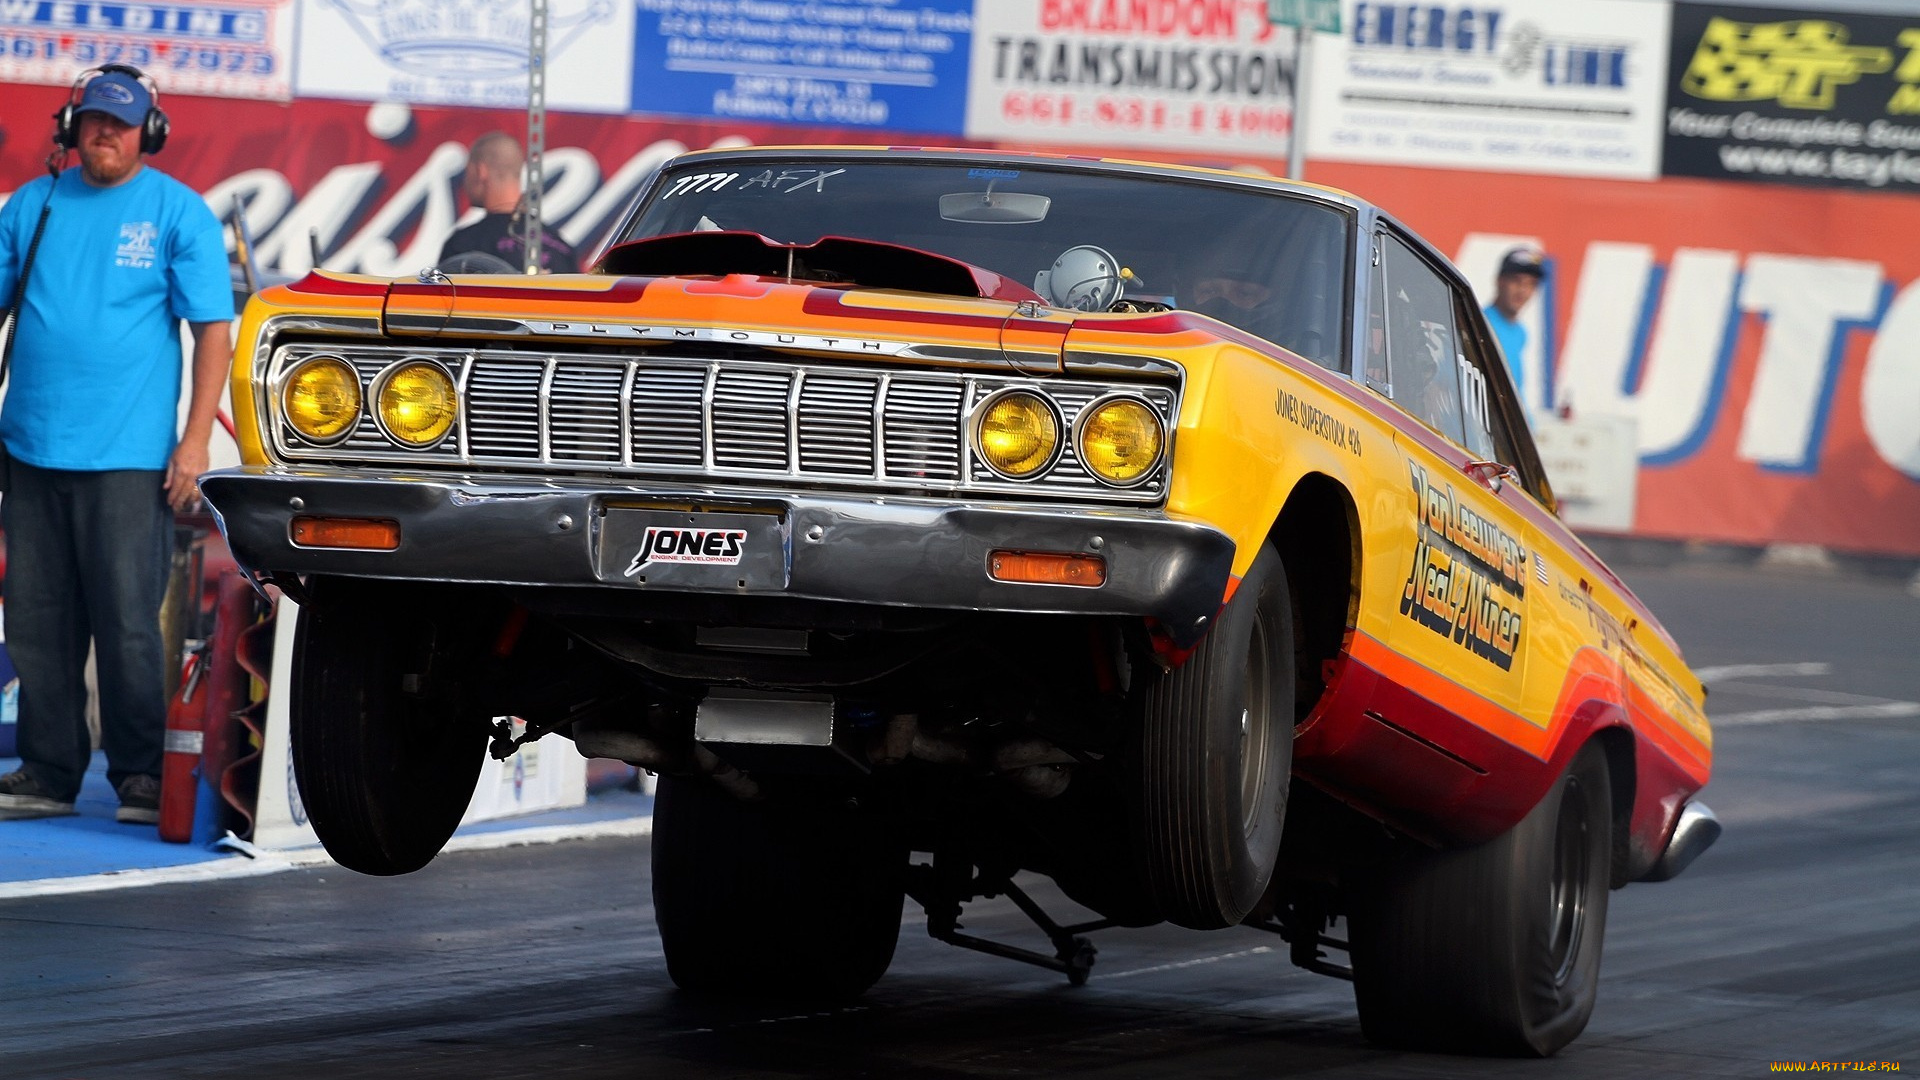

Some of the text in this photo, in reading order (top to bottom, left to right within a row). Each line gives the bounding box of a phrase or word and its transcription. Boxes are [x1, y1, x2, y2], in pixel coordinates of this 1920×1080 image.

[0, 1, 261, 39] WELDING
[1351, 3, 1504, 54] ENERGY
[0, 38, 57, 60] 61
[994, 36, 1297, 97] TRANSMISSION
[1542, 44, 1631, 88] LINK
[1668, 107, 1731, 139] Your
[1732, 111, 1865, 147] Complete
[738, 168, 847, 194] AFX
[115, 258, 153, 269] STAFF
[552, 323, 882, 351] PLYMOUTH
[1275, 387, 1362, 457] JONES SUPERSTOCK 426
[627, 529, 745, 573] JONES
[681, 555, 738, 563] DEVELOPMENT
[1403, 540, 1456, 633] Neal
[1456, 571, 1522, 665] Miner
